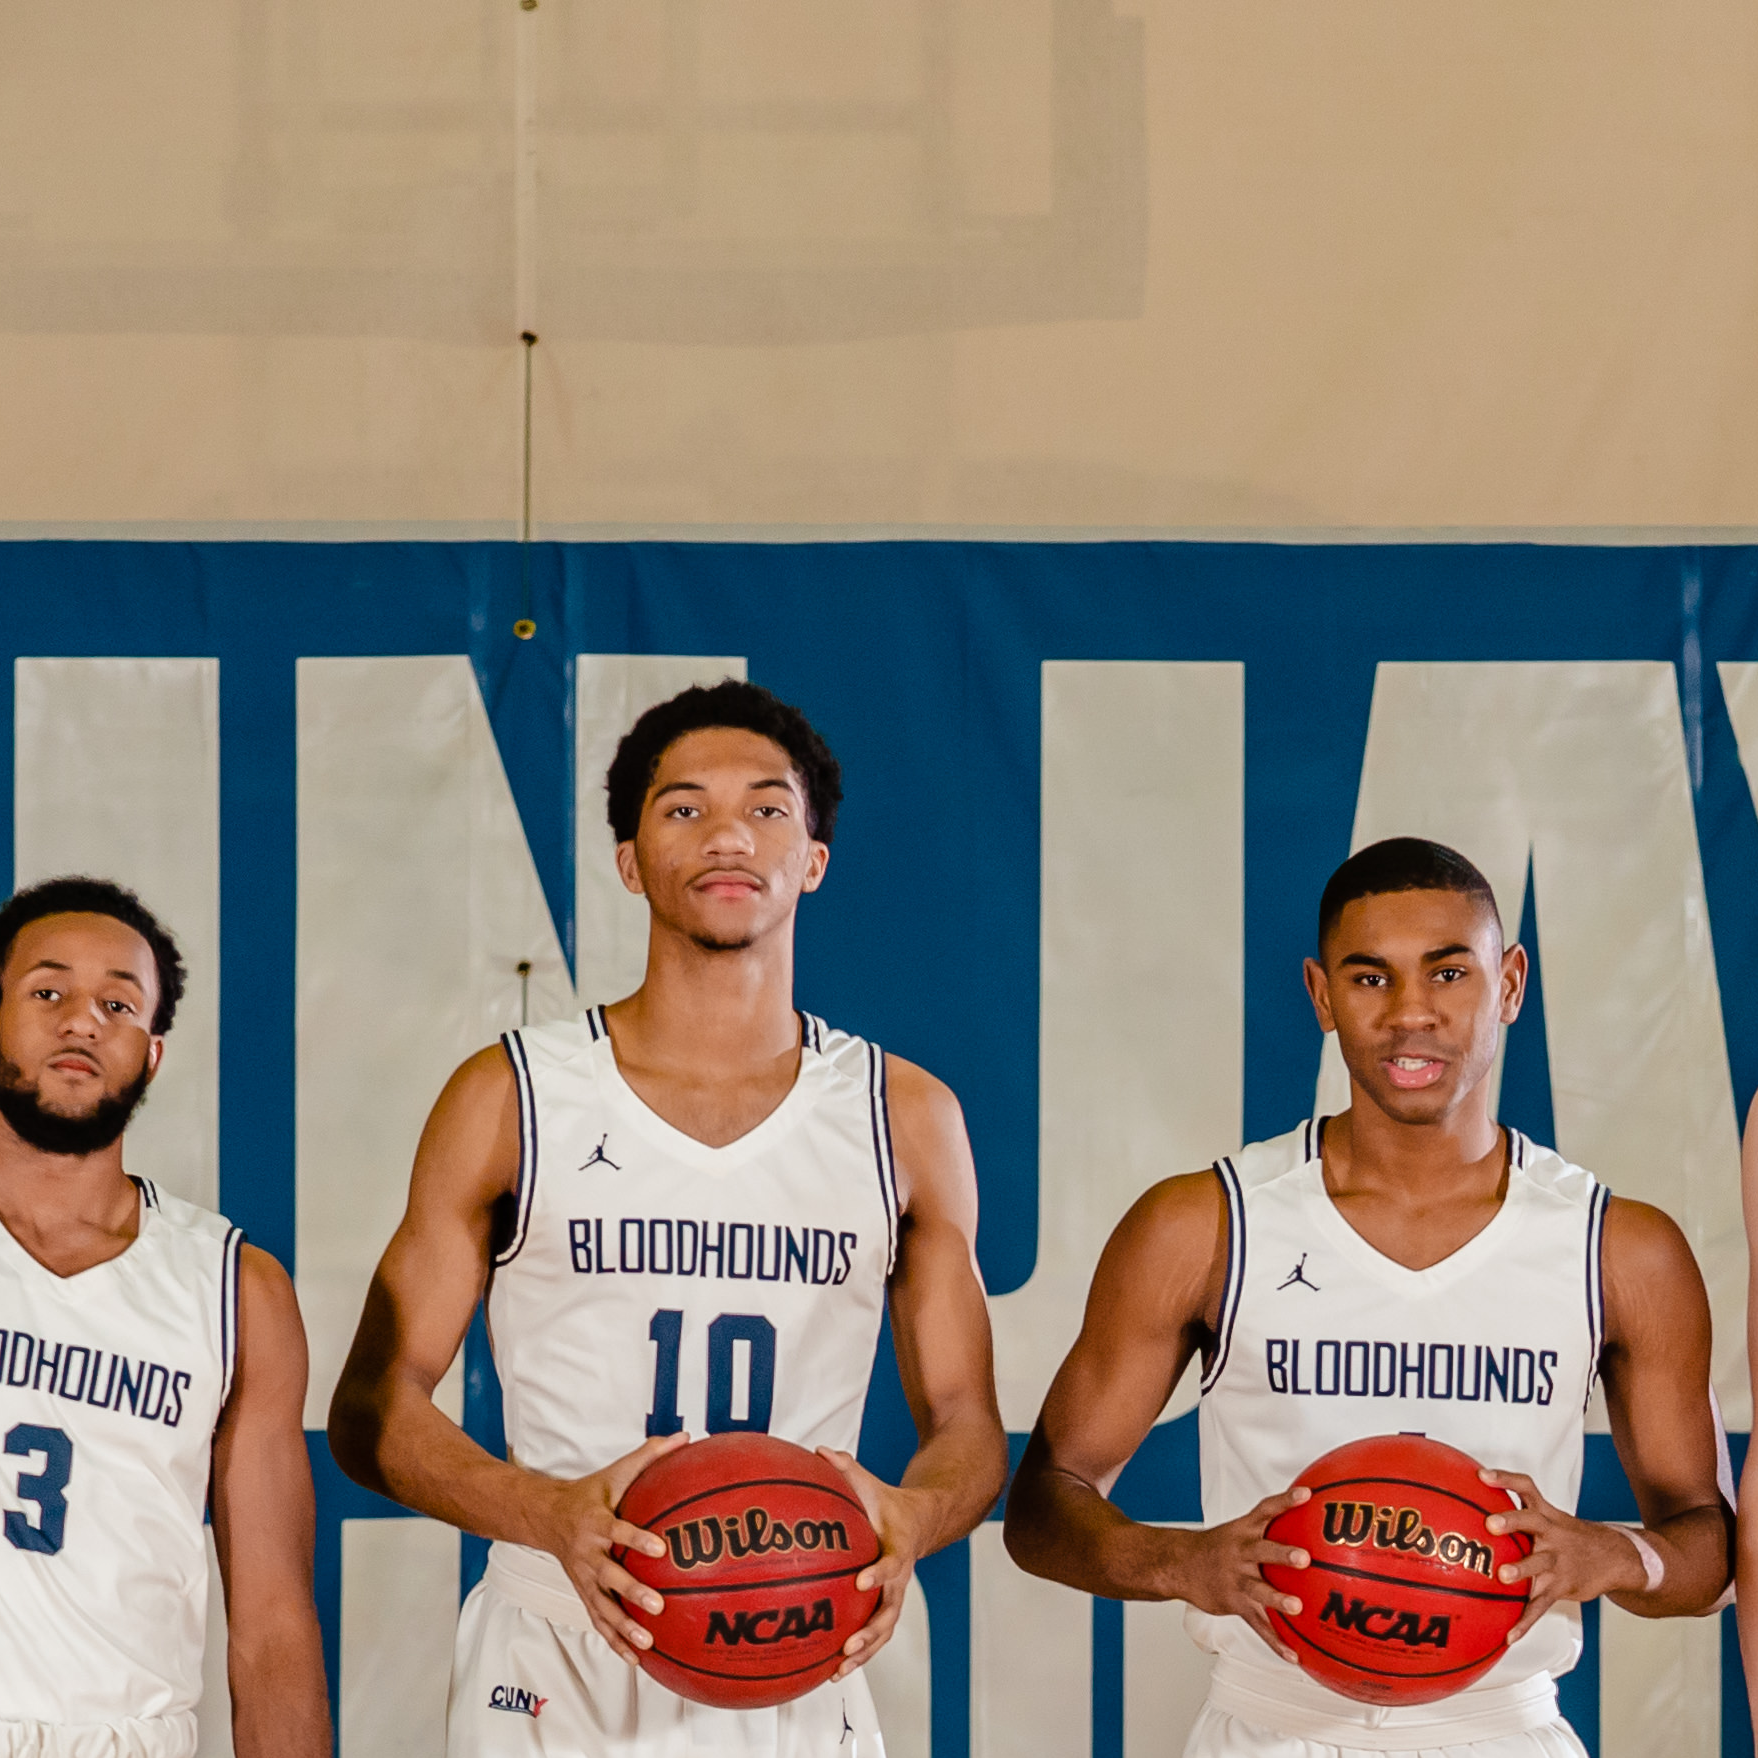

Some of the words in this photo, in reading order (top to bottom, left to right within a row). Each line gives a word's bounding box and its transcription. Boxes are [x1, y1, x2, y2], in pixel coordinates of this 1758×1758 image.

[568, 1217, 857, 1286] BLOODHOUNDS
[645, 1308, 777, 1439] 10
[1265, 1338, 1558, 1406] BLOODHOUNDS
[3, 1422, 73, 1556] 3
[664, 1506, 851, 1572] Wilson
[1322, 1502, 1493, 1579] Wilson
[704, 1598, 834, 1645] NCAA
[1319, 1589, 1451, 1648] NCAA
[488, 1684, 549, 1718] CUNY
